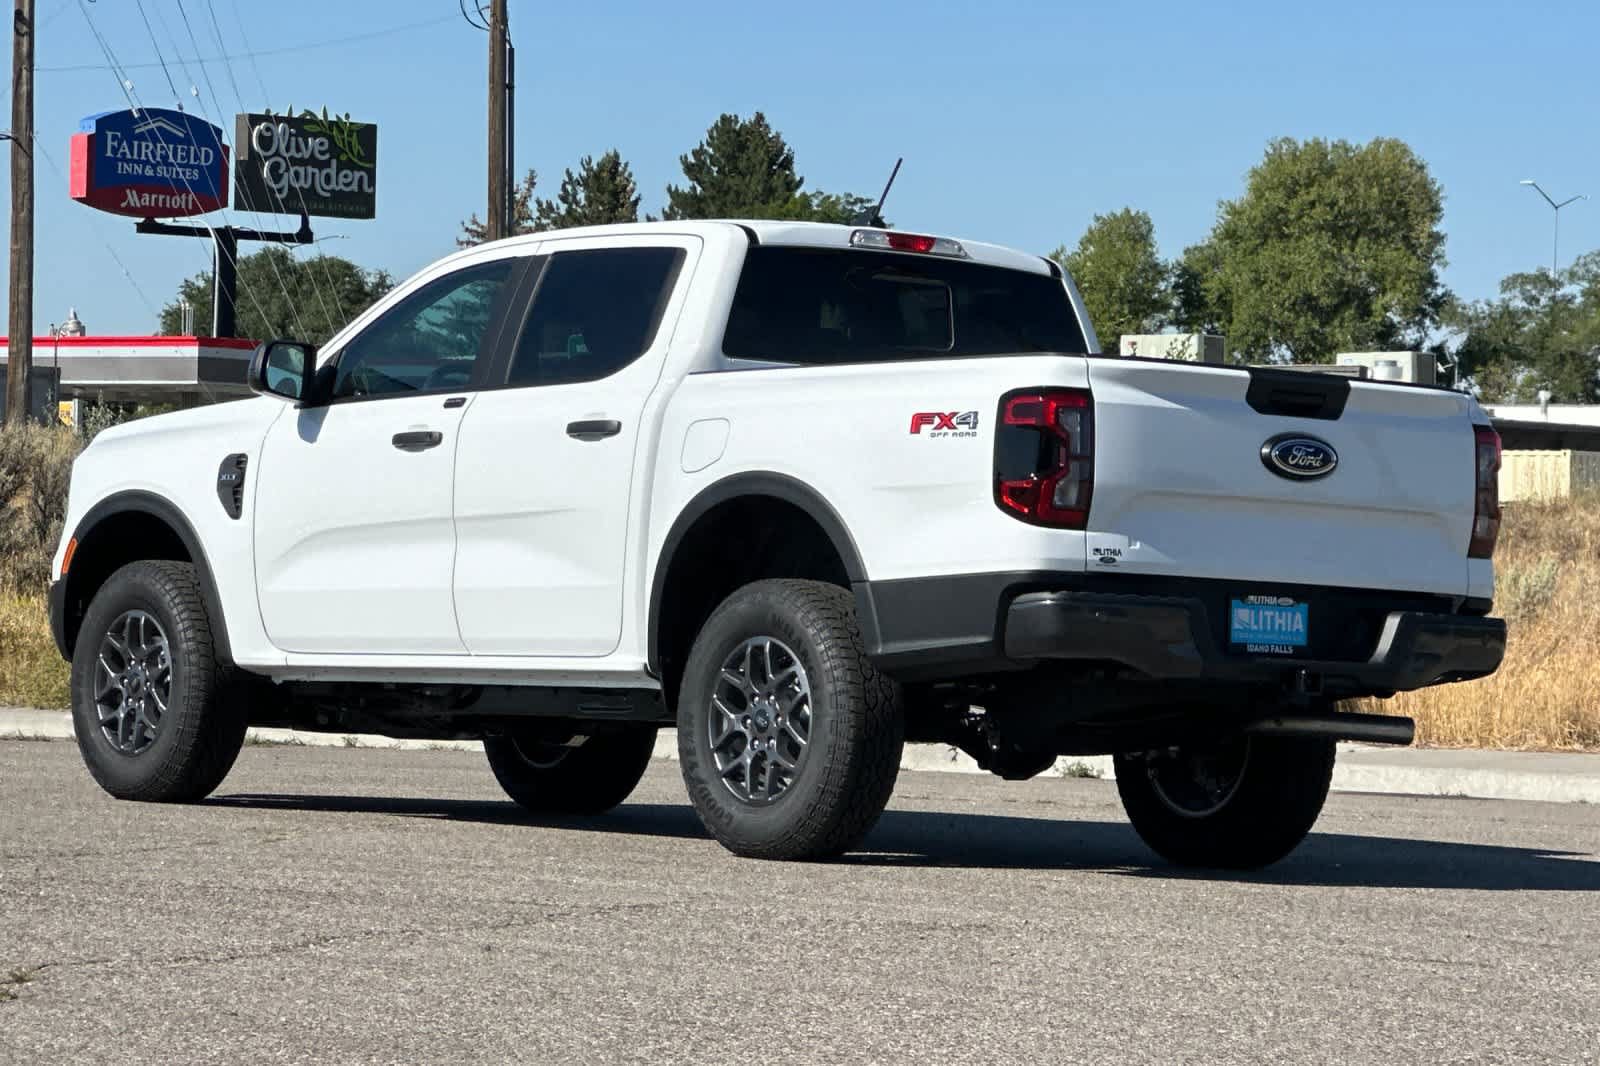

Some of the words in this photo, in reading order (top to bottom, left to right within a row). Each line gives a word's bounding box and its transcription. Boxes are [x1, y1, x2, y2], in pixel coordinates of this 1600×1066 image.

[105, 131, 214, 166] FAIRFIELD
[252, 122, 330, 160] Olive
[117, 162, 143, 176] INN
[144, 165, 155, 176] &
[156, 166, 199, 180] SUITES
[263, 157, 374, 199] Garden
[120, 188, 194, 209] Marriott
[910, 411, 979, 434] FX4
[1288, 446, 1323, 467] Ford
[1099, 548, 1122, 557] LITHIA
[1254, 595, 1277, 604] LITHIA
[1249, 608, 1304, 632] LITHIA
[1247, 644, 1269, 653] IDAHO
[1270, 645, 1294, 654] FALLS
